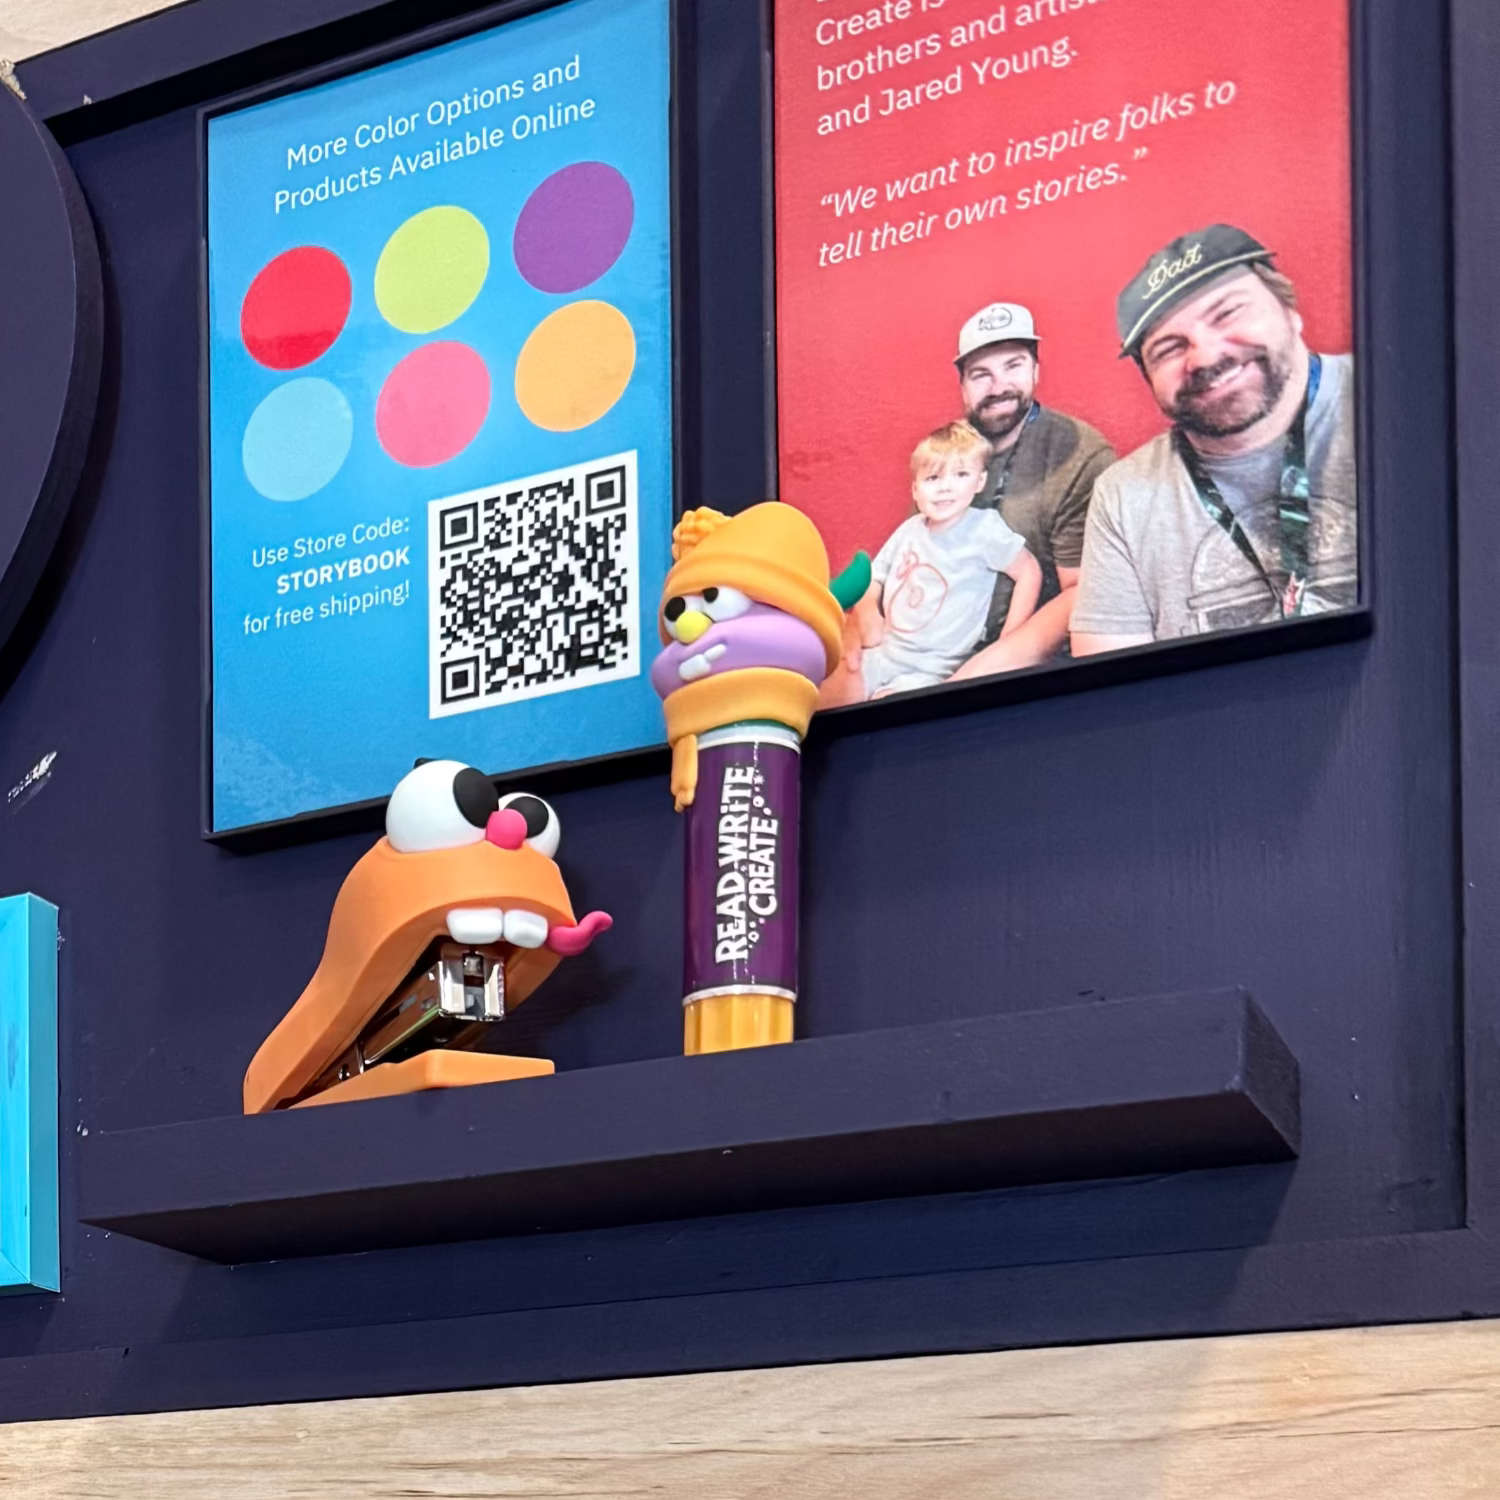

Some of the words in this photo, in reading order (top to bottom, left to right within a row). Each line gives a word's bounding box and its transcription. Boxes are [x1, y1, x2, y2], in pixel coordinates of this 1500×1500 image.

[815, 0, 911, 46] Create
[817, 30, 942, 91] brothers
[949, 8, 1006, 47] and
[286, 136, 347, 170] More
[354, 112, 420, 149] Color
[426, 79, 524, 126] Options
[532, 54, 580, 93] and
[816, 96, 870, 135] and
[878, 66, 962, 117] Jared
[970, 36, 1079, 85] Young.
[274, 166, 382, 215] Products
[388, 126, 504, 180] Available
[511, 98, 596, 140] Online
[885, 156, 959, 203] want
[966, 148, 995, 179] to
[1004, 111, 1110, 167] inspire
[1114, 87, 1195, 142] folks
[1203, 79, 1236, 109] to
[818, 230, 863, 267] tell
[870, 211, 940, 253] their
[944, 194, 1007, 230] own
[1141, 243, 1203, 299] Dad
[252, 546, 289, 568] Use
[293, 532, 347, 559] Store
[352, 516, 410, 544] Code:
[276, 545, 411, 595] STORYBOOK
[243, 614, 271, 636] for
[275, 605, 314, 629] free
[319, 579, 411, 619] shipping!
[748, 816, 779, 917] CREATE
[715, 868, 750, 964] READ
